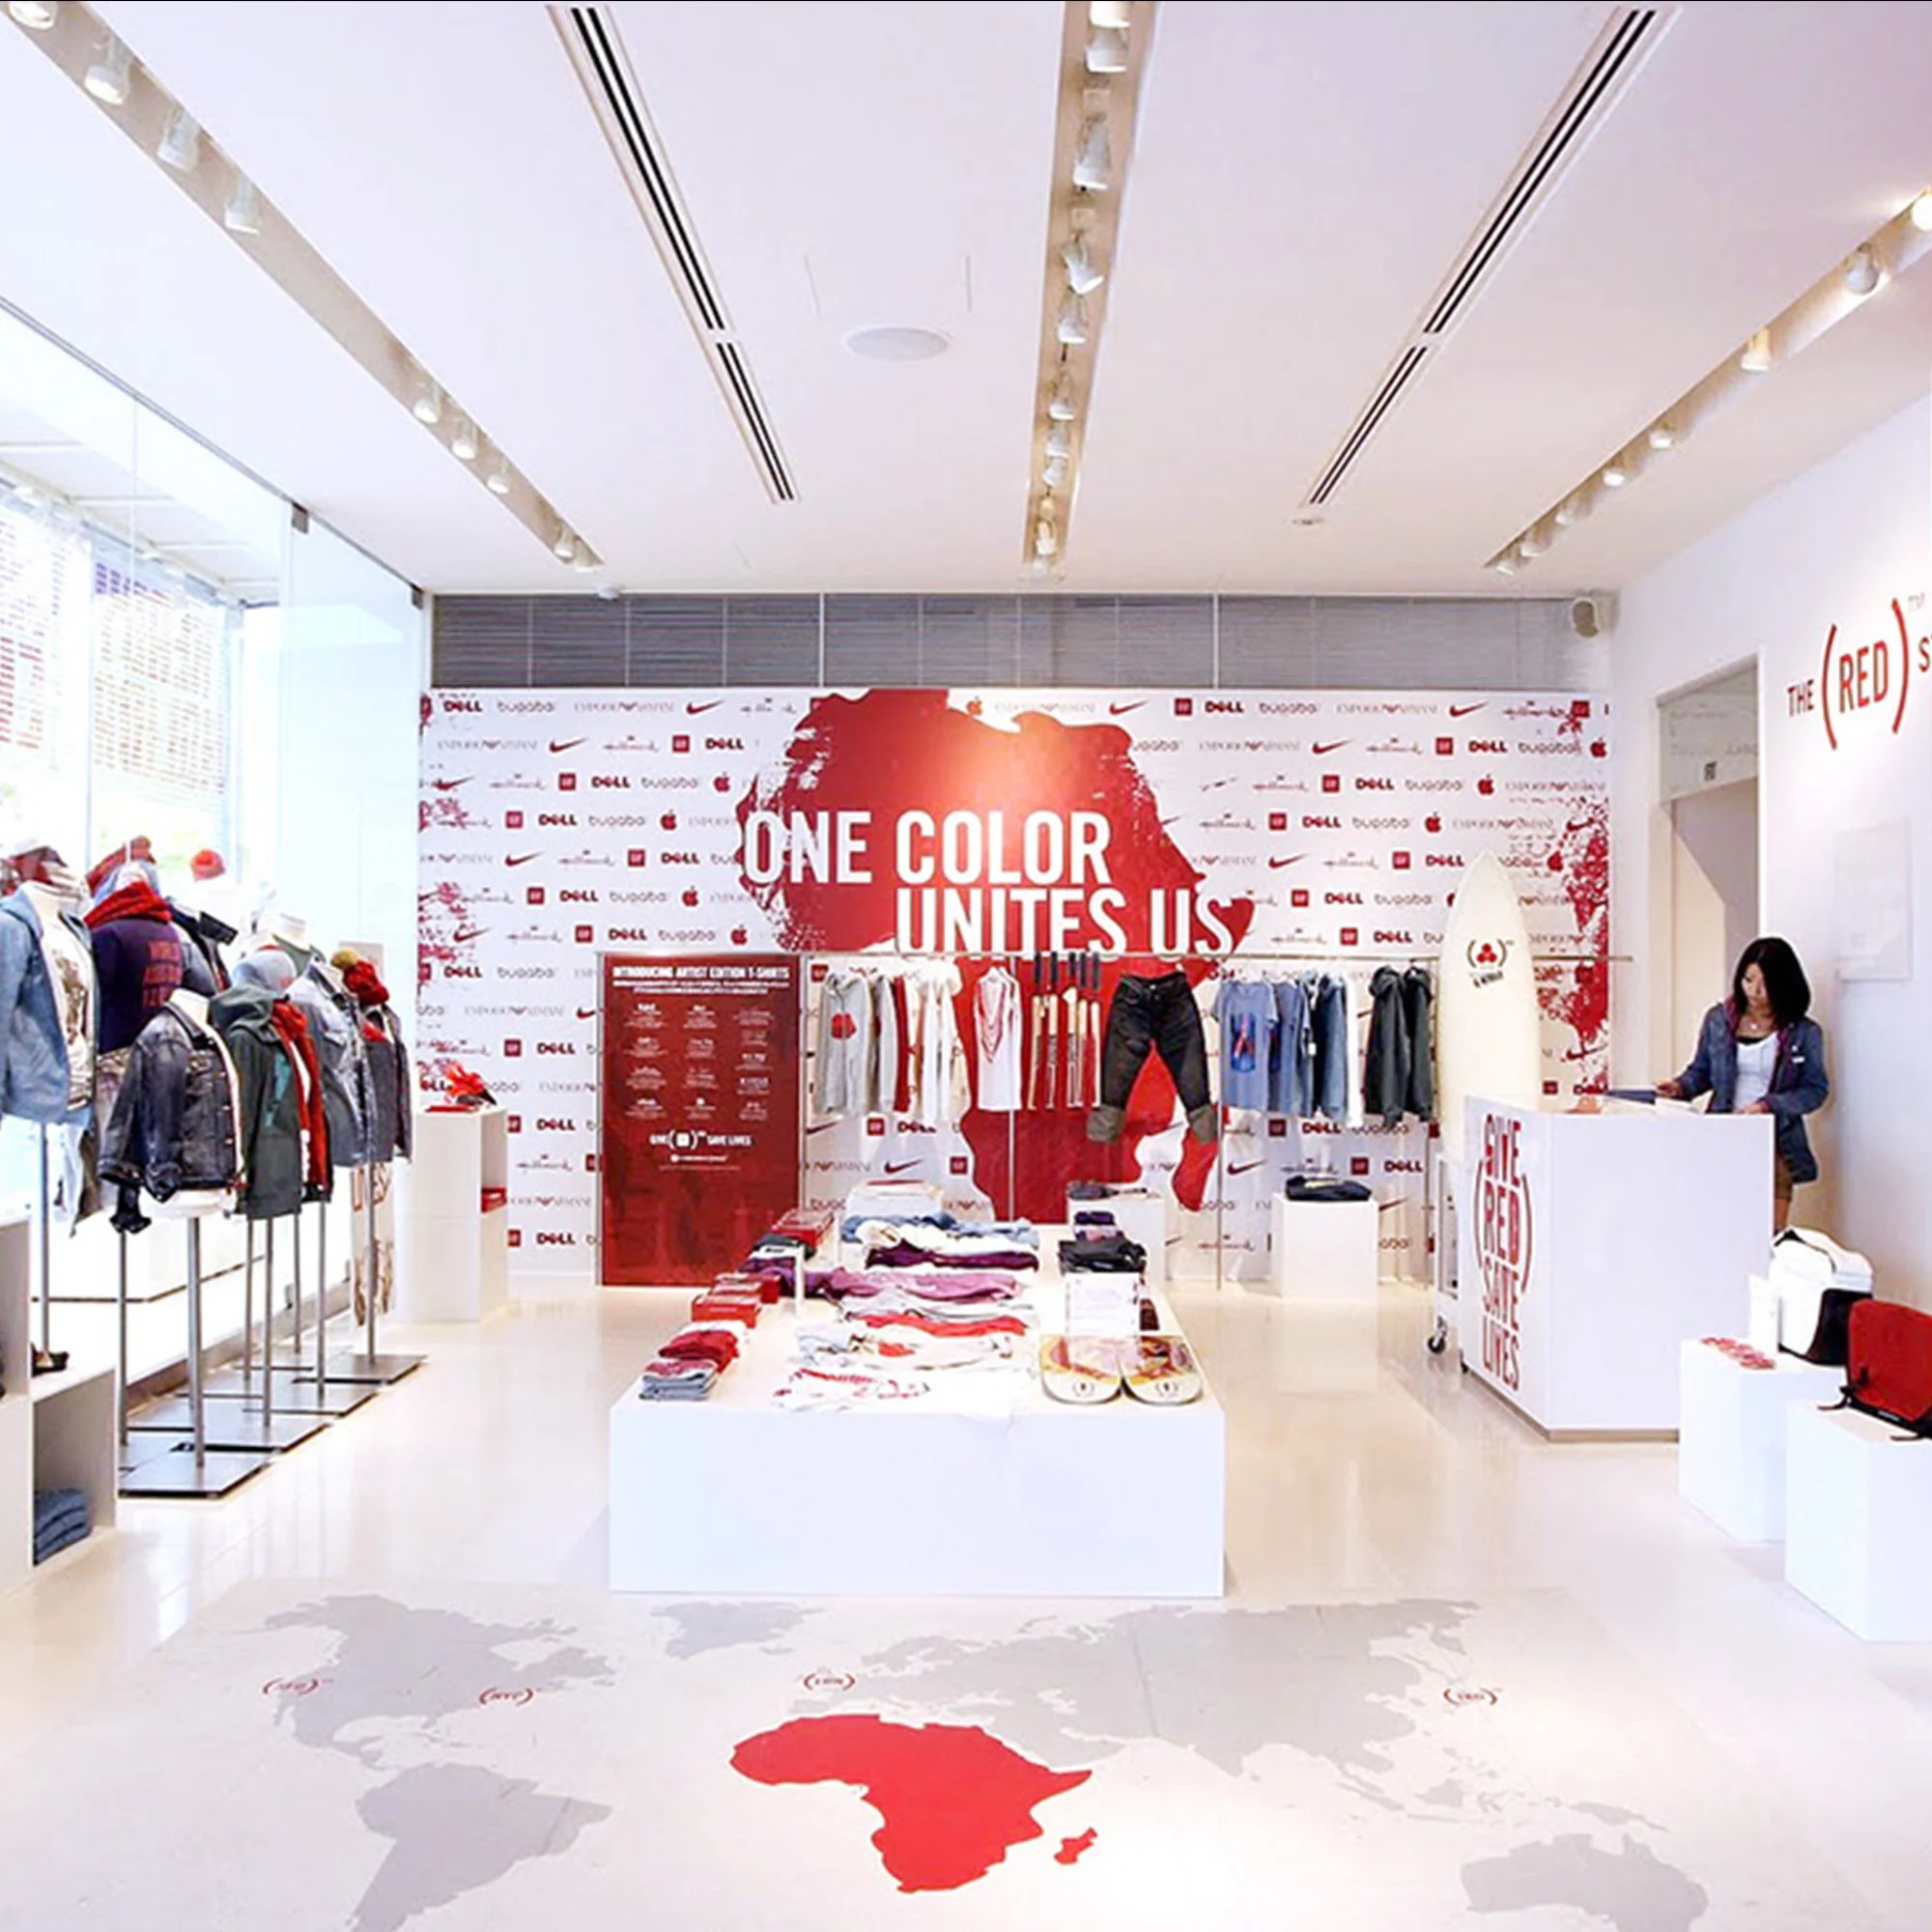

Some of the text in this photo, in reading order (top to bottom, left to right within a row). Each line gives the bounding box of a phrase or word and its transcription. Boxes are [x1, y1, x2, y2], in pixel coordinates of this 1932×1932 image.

[1787, 679, 1814, 717] THE
[1822, 597, 1909, 751] (RED)
[1918, 634, 1932, 672] S
[443, 700, 482, 712] DELL
[1205, 700, 1244, 713] DELL
[705, 738, 744, 750] DELL
[1468, 740, 1508, 753] DELL
[591, 776, 630, 788] DELL
[1355, 778, 1394, 790] DELL
[538, 814, 577, 826] DELL
[1302, 816, 1341, 828] DELL
[743, 810, 1110, 885] ONE COLOR
[661, 852, 699, 865] DELL
[1426, 855, 1464, 867] DELL
[559, 890, 599, 902] DELL
[1324, 893, 1363, 904] DELL
[895, 888, 1235, 961] UNITES US
[608, 928, 646, 941] DELL
[1374, 930, 1412, 943] DELL
[443, 965, 482, 978] DELL
[537, 1042, 576, 1055] DELL
[536, 1119, 576, 1130] DELL
[1302, 1122, 1344, 1134] DELL
[1484, 1114, 1521, 1187] GIVE
[1384, 1160, 1423, 1173] DELL
[536, 1233, 575, 1244] DELL
[1483, 1255, 1519, 1331] SAVE
[1483, 1314, 1519, 1391] LIVES
